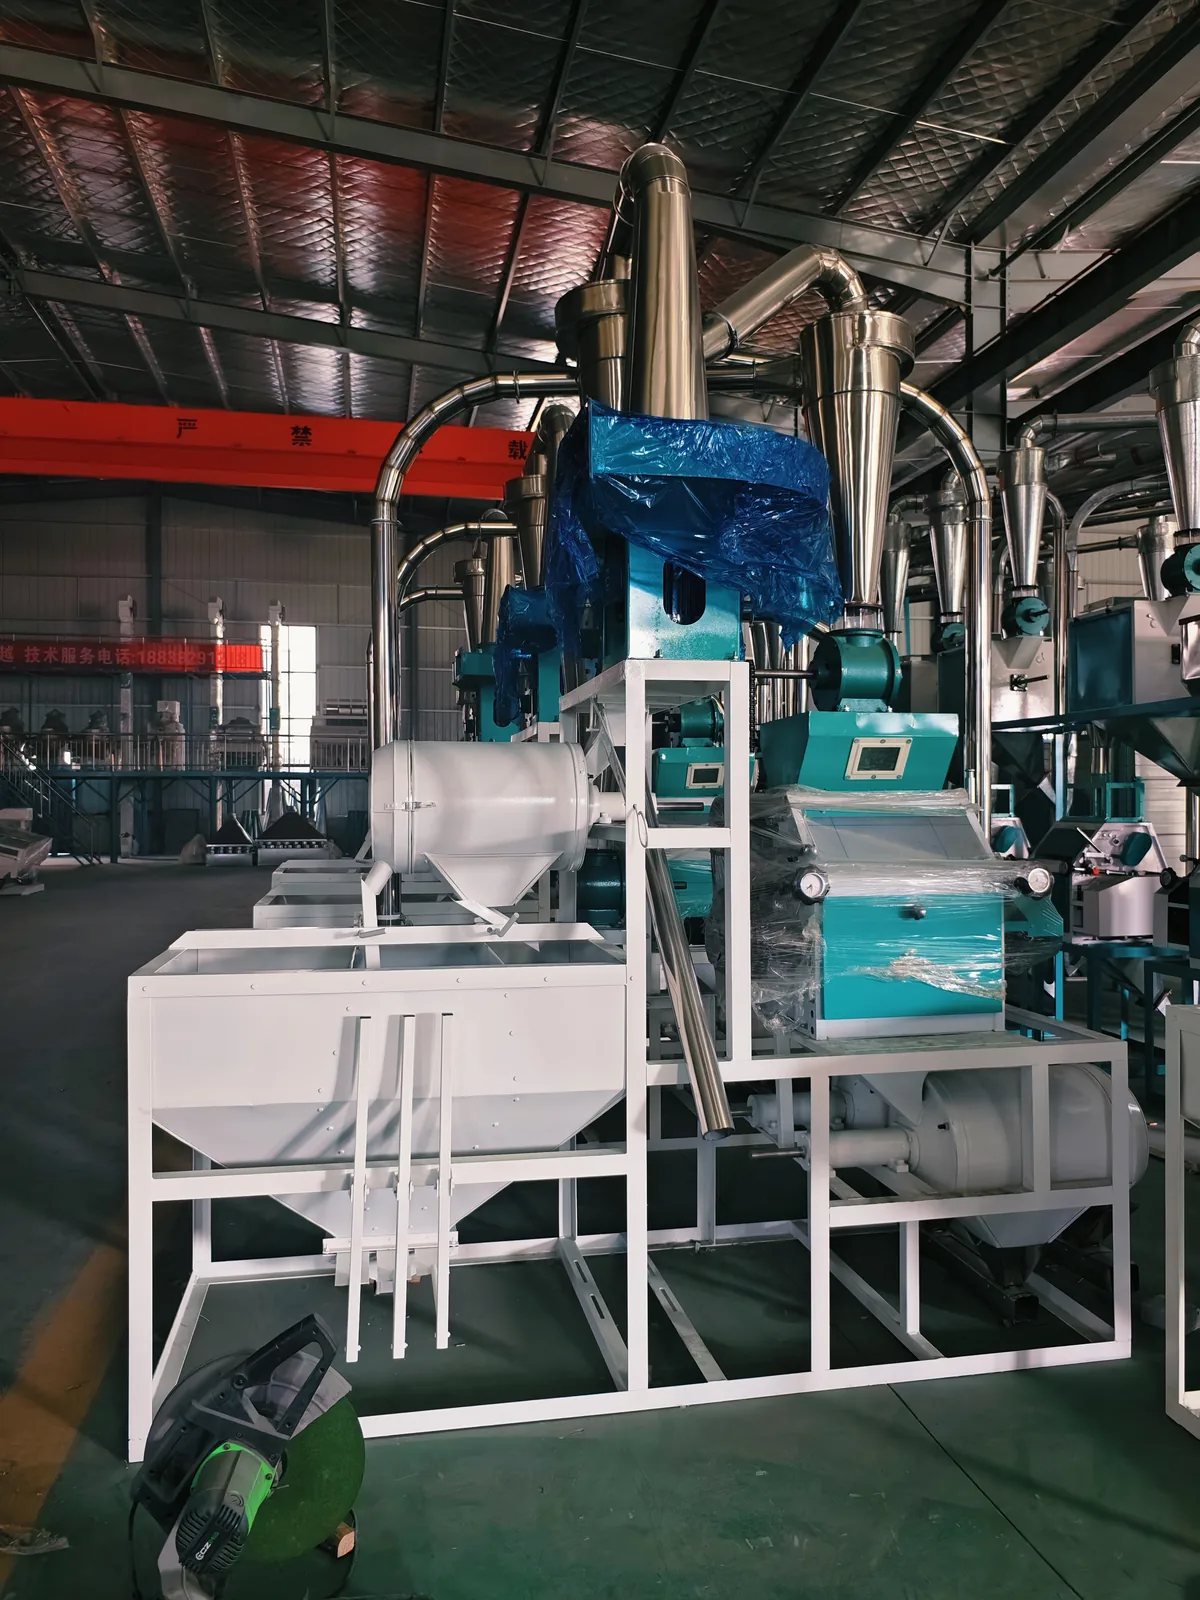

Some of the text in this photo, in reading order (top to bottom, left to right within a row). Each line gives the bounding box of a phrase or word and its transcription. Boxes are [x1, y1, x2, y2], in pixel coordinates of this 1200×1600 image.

[176, 417, 529, 460] 严 禁 载
